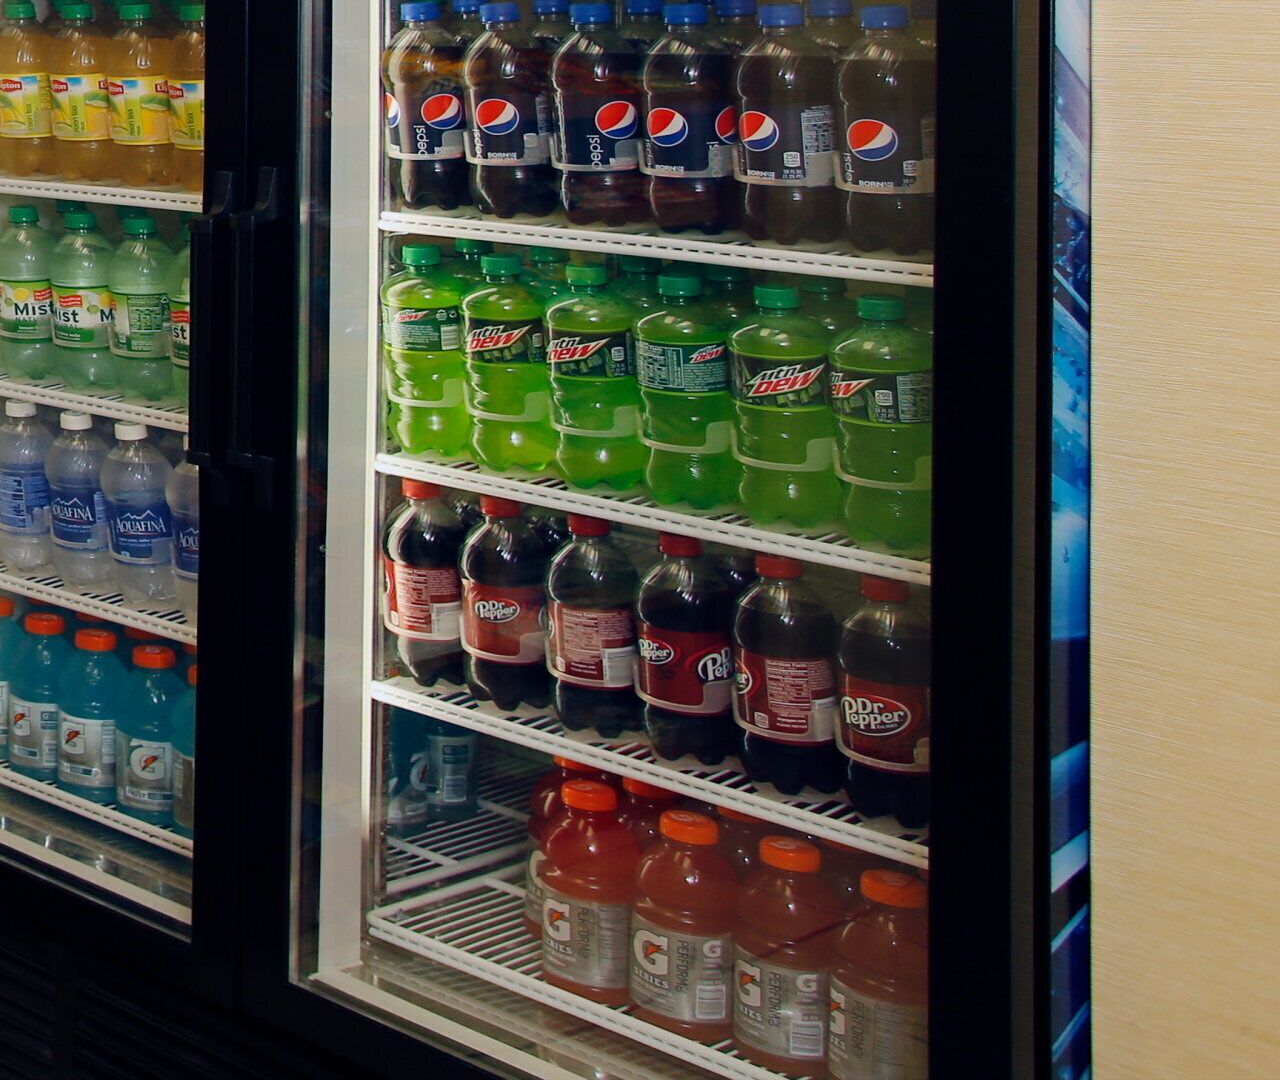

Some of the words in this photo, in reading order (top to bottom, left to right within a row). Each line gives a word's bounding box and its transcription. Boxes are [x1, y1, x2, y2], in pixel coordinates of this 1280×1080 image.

[414, 125, 428, 158] pepsi
[587, 134, 602, 169] pepsi
[843, 152, 856, 187] pepsi
[14, 302, 55, 317] Mist
[758, 365, 802, 380] mtn
[754, 369, 822, 397] DEW
[116, 517, 166, 534] AQUAFINA
[477, 601, 517, 619] Pepper
[490, 601, 504, 611] Dr
[842, 695, 905, 728] Pepper
[856, 695, 884, 712] Dr
[633, 966, 669, 989] SERIES
